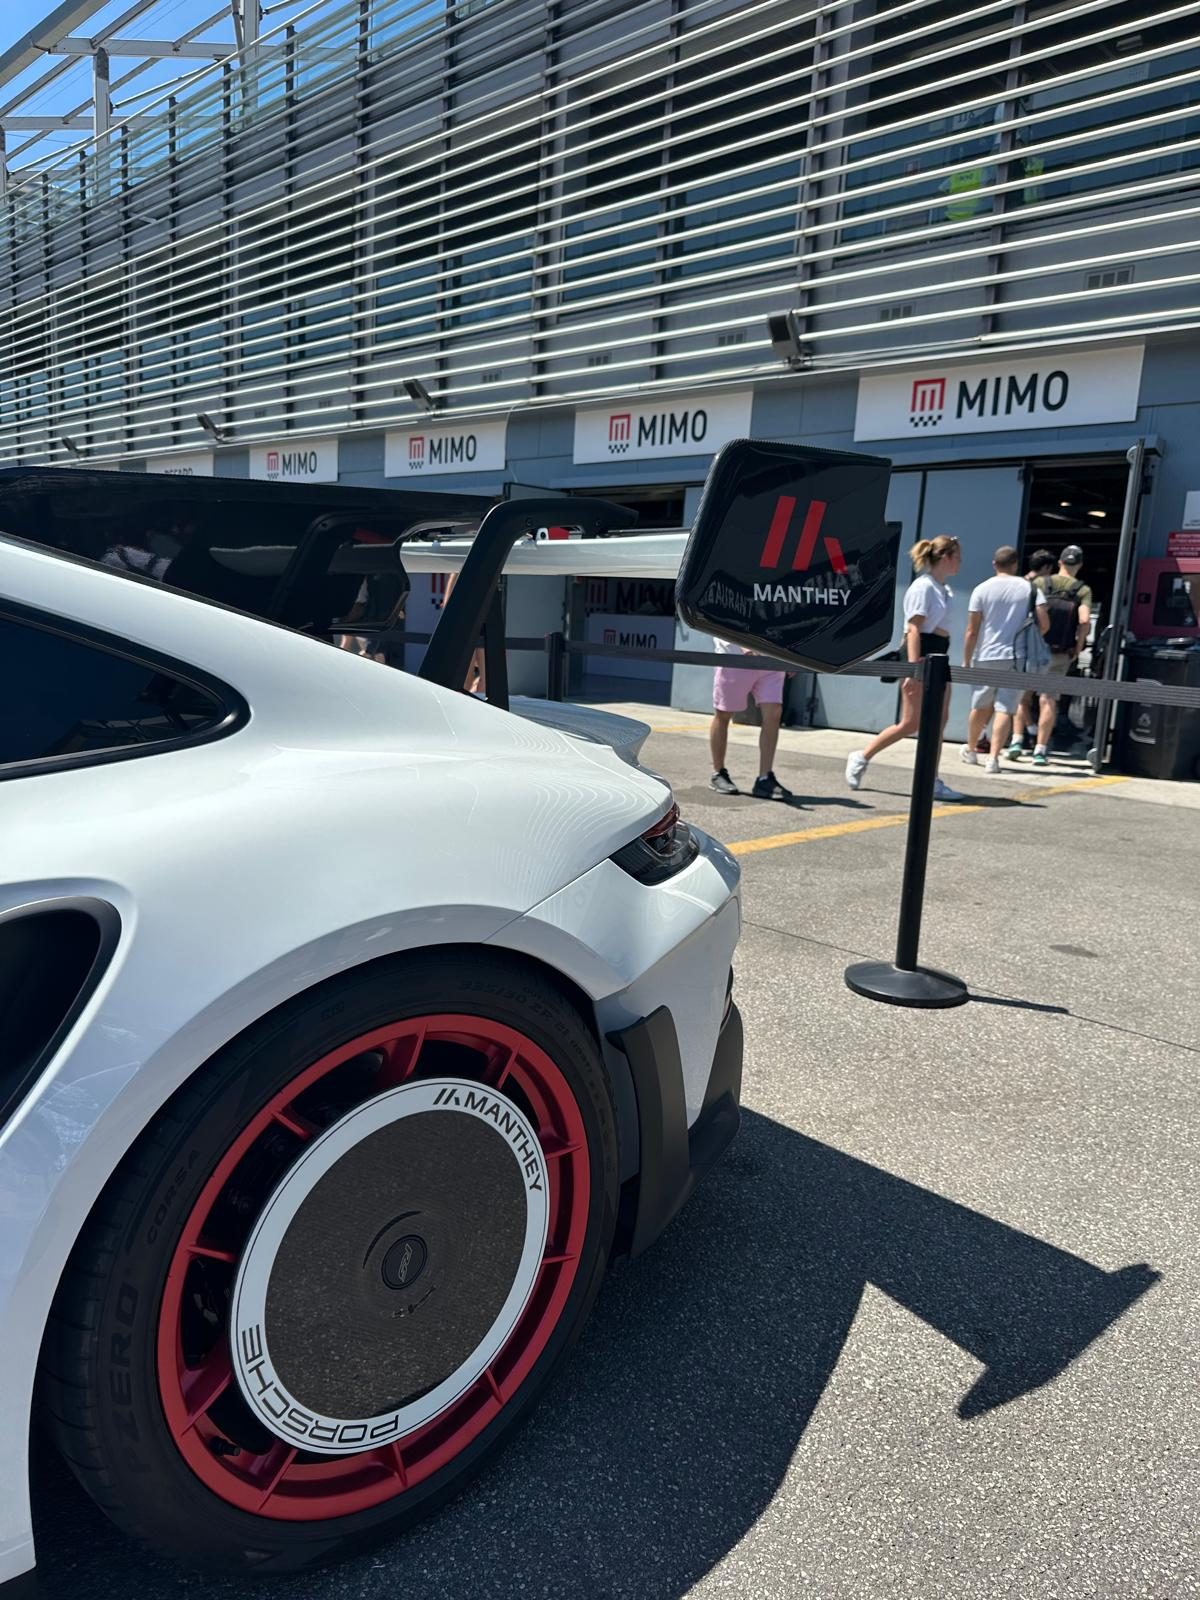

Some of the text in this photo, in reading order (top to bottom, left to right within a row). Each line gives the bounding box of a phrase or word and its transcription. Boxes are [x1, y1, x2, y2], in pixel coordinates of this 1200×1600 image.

[958, 370, 1068, 418] MIMO
[429, 434, 477, 464] MIMO
[638, 410, 708, 448] MIMO
[281, 452, 317, 477] MIMO
[753, 583, 851, 606] MANTHEY
[463, 1091, 543, 1191] MANTHEY
[147, 1149, 201, 1245] CORSA
[109, 1282, 140, 1442] ZERO
[241, 1324, 400, 1443] PORSCHE
